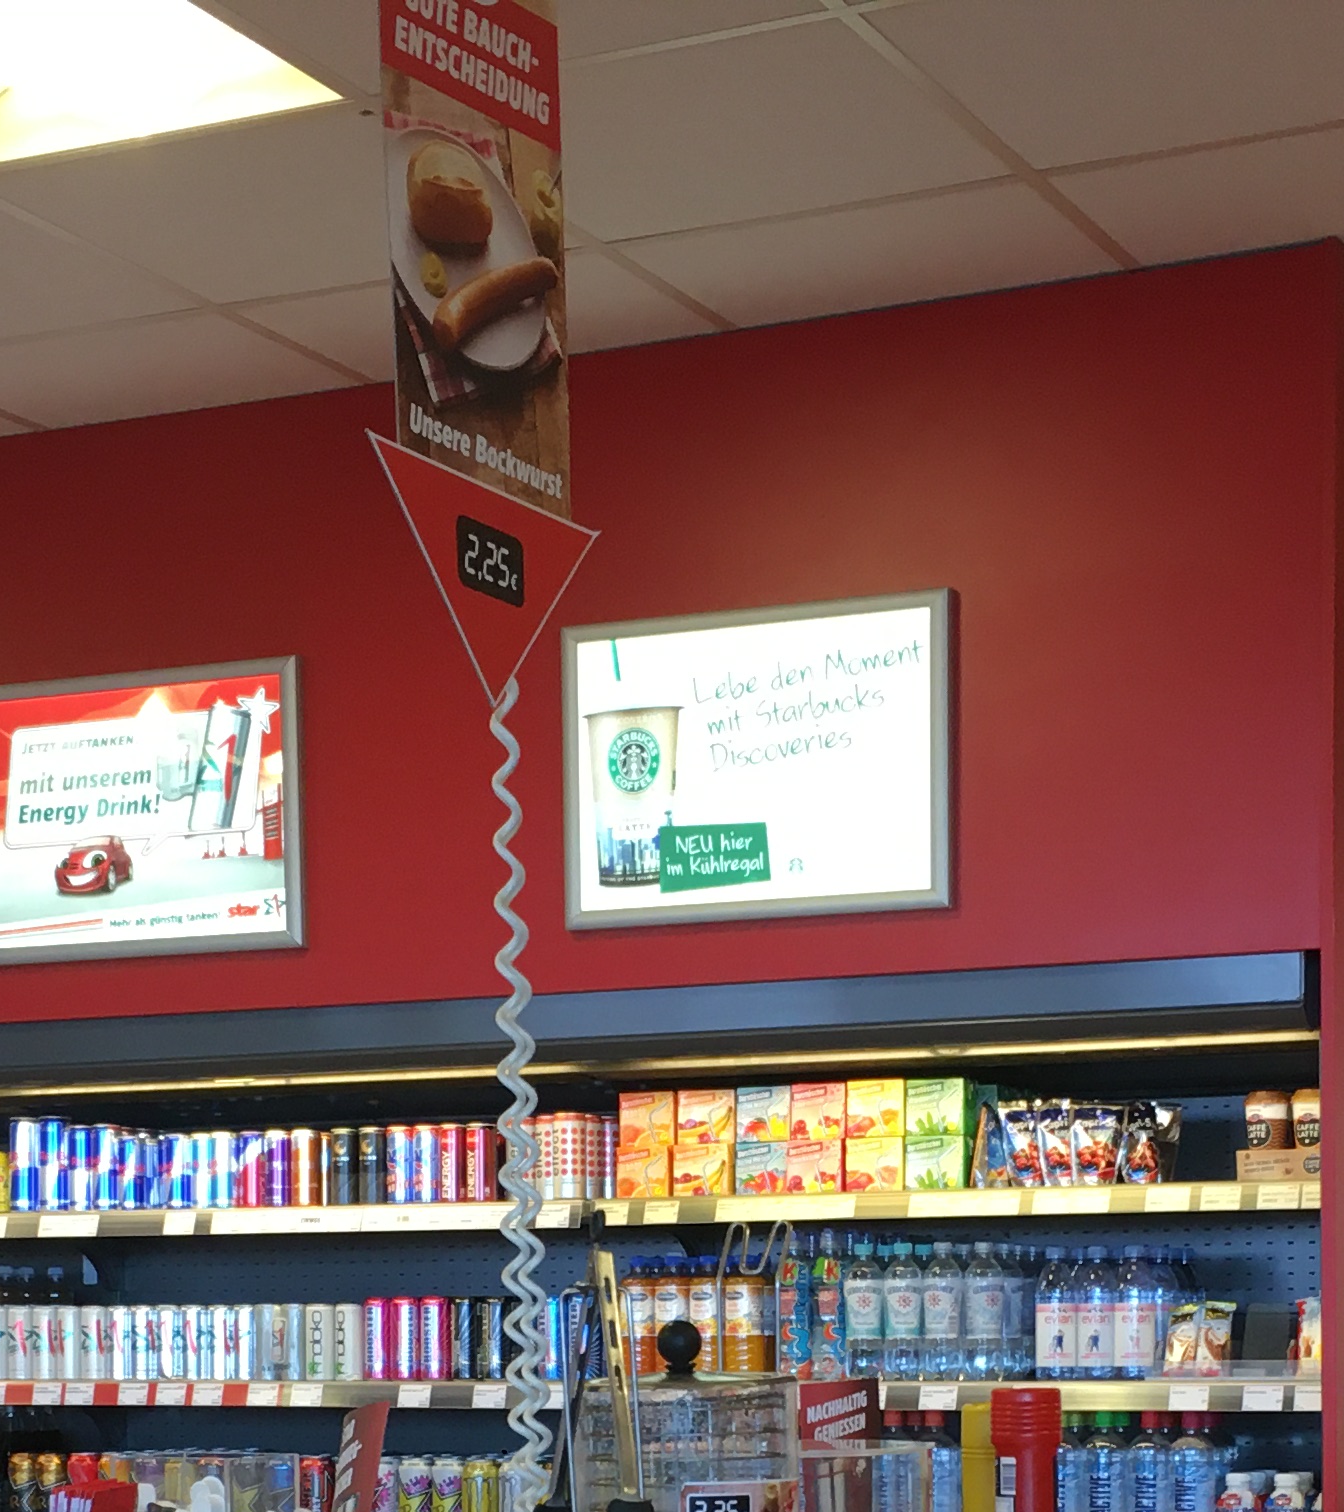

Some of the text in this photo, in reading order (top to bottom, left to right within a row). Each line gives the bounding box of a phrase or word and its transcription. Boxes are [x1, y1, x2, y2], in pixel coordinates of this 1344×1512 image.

[463, 8, 540, 74] BAUCH-
[394, 14, 551, 126] ENTSCHEIDUNG
[409, 402, 563, 500] Unsere Bockwurst
[692, 639, 924, 705] Lebe den Moment
[707, 684, 886, 735] mit Starbucks
[608, 731, 658, 760] STARBUCKS
[709, 723, 853, 773] Discoveries
[19, 768, 152, 795] mit unserem
[614, 772, 654, 791] COFFEE
[17, 793, 161, 826] Energy Drink!
[675, 831, 754, 855] NEU hier
[665, 851, 764, 877] im Kühlregal
[440, 1151, 450, 1199] ENERGY
[465, 1150, 475, 1198] ENERGY
[1044, 1312, 1073, 1325] evian
[1081, 1312, 1110, 1325] evian
[1121, 1312, 1151, 1325] evian
[806, 1389, 868, 1424] NACHHALTIG
[814, 1412, 867, 1442] GENIESSEN
